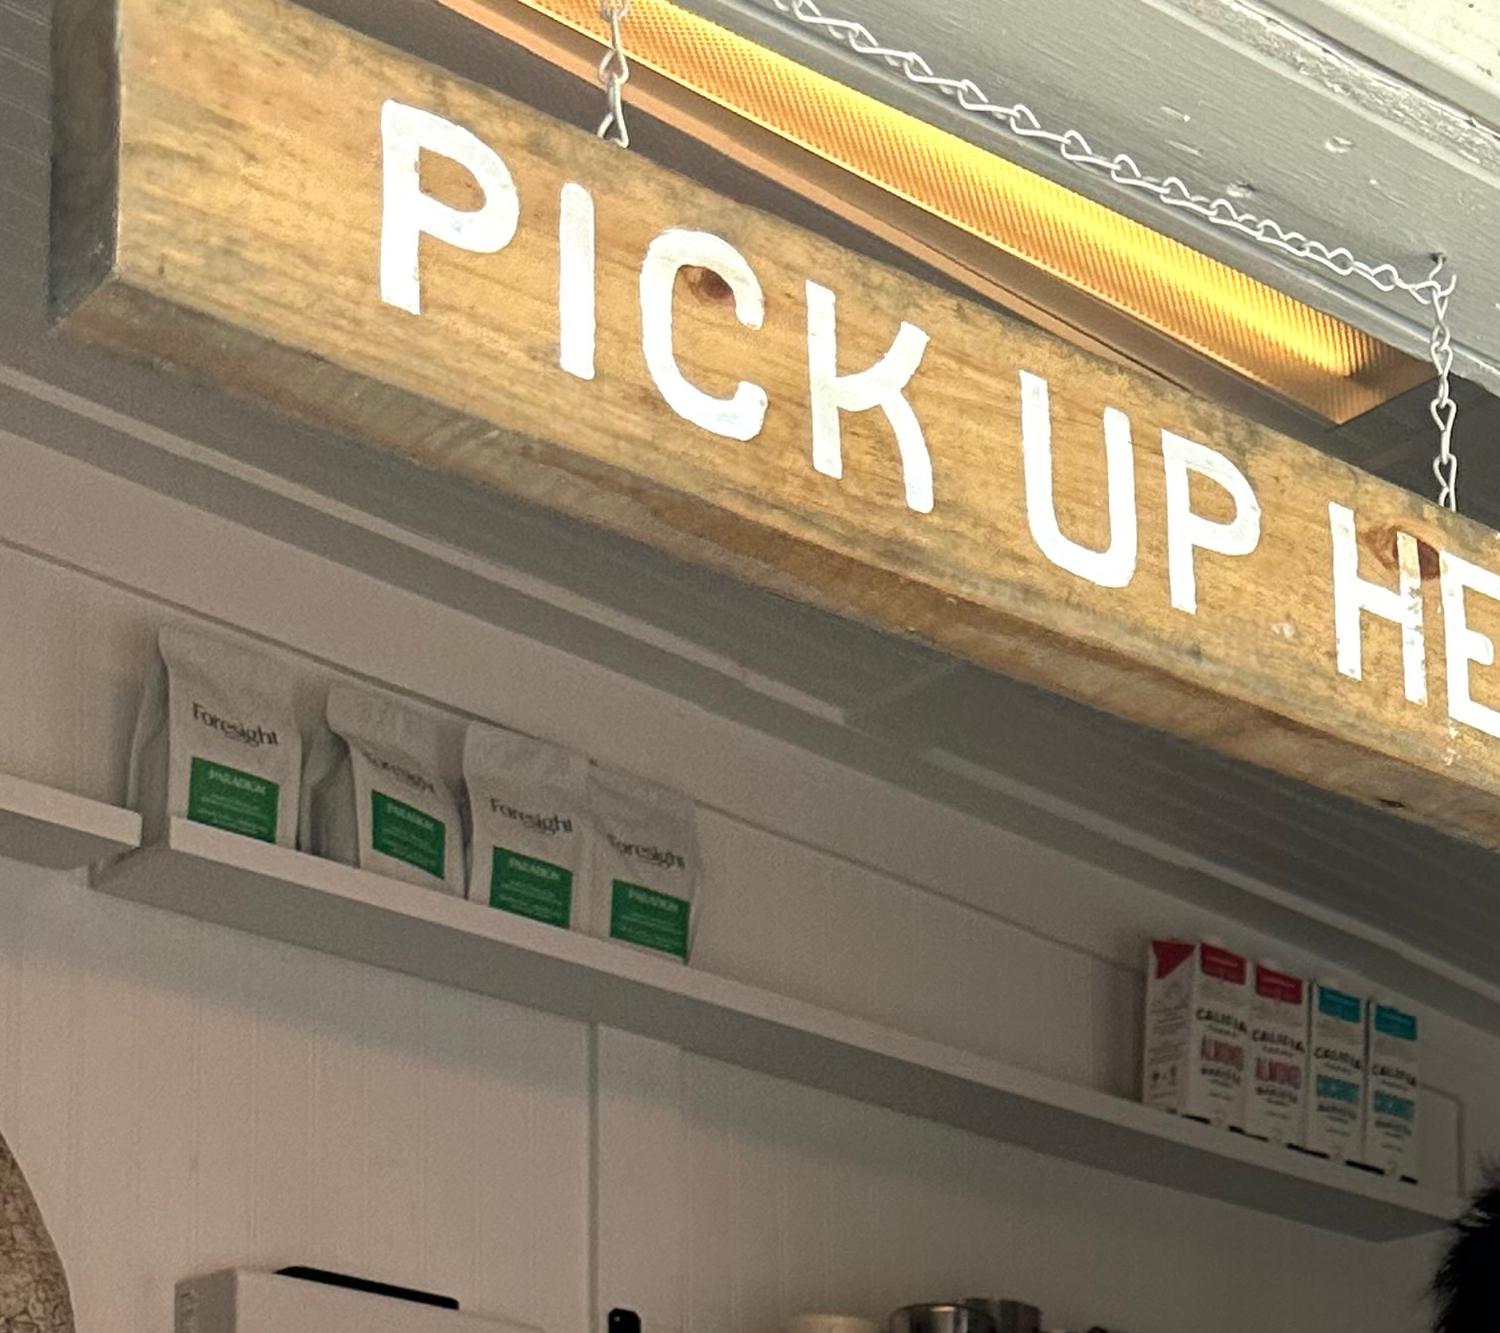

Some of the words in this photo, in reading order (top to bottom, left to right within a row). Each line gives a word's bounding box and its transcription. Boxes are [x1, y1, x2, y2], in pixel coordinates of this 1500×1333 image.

[380, 98, 934, 514] PICK
[1019, 369, 1262, 614] UP
[192, 702, 280, 748] Foresight
